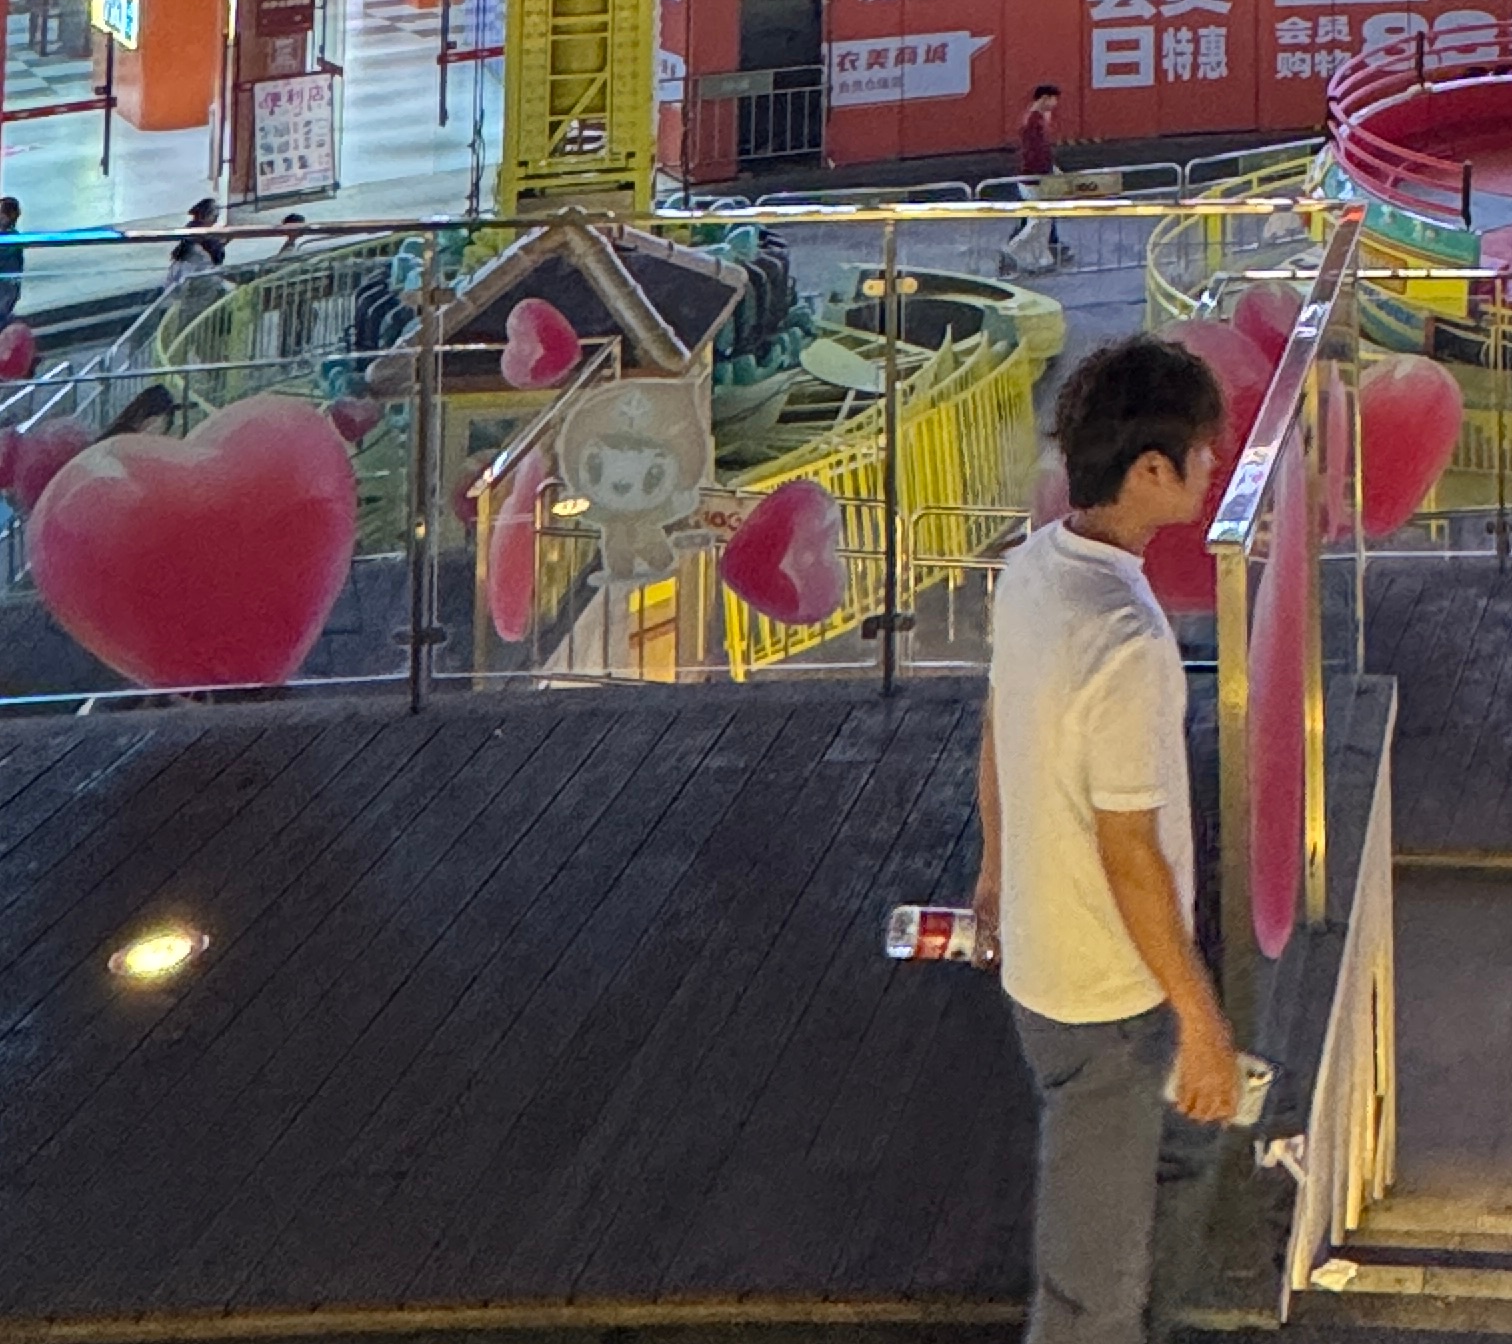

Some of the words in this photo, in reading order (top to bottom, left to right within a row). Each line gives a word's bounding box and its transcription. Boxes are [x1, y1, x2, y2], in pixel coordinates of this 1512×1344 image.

[1274, 14, 1352, 45] 会员
[835, 42, 950, 74] 衣美商城
[1092, 25, 1229, 90] 日特惠
[1276, 50, 1352, 80] 购物
[259, 85, 325, 115] 便利店
